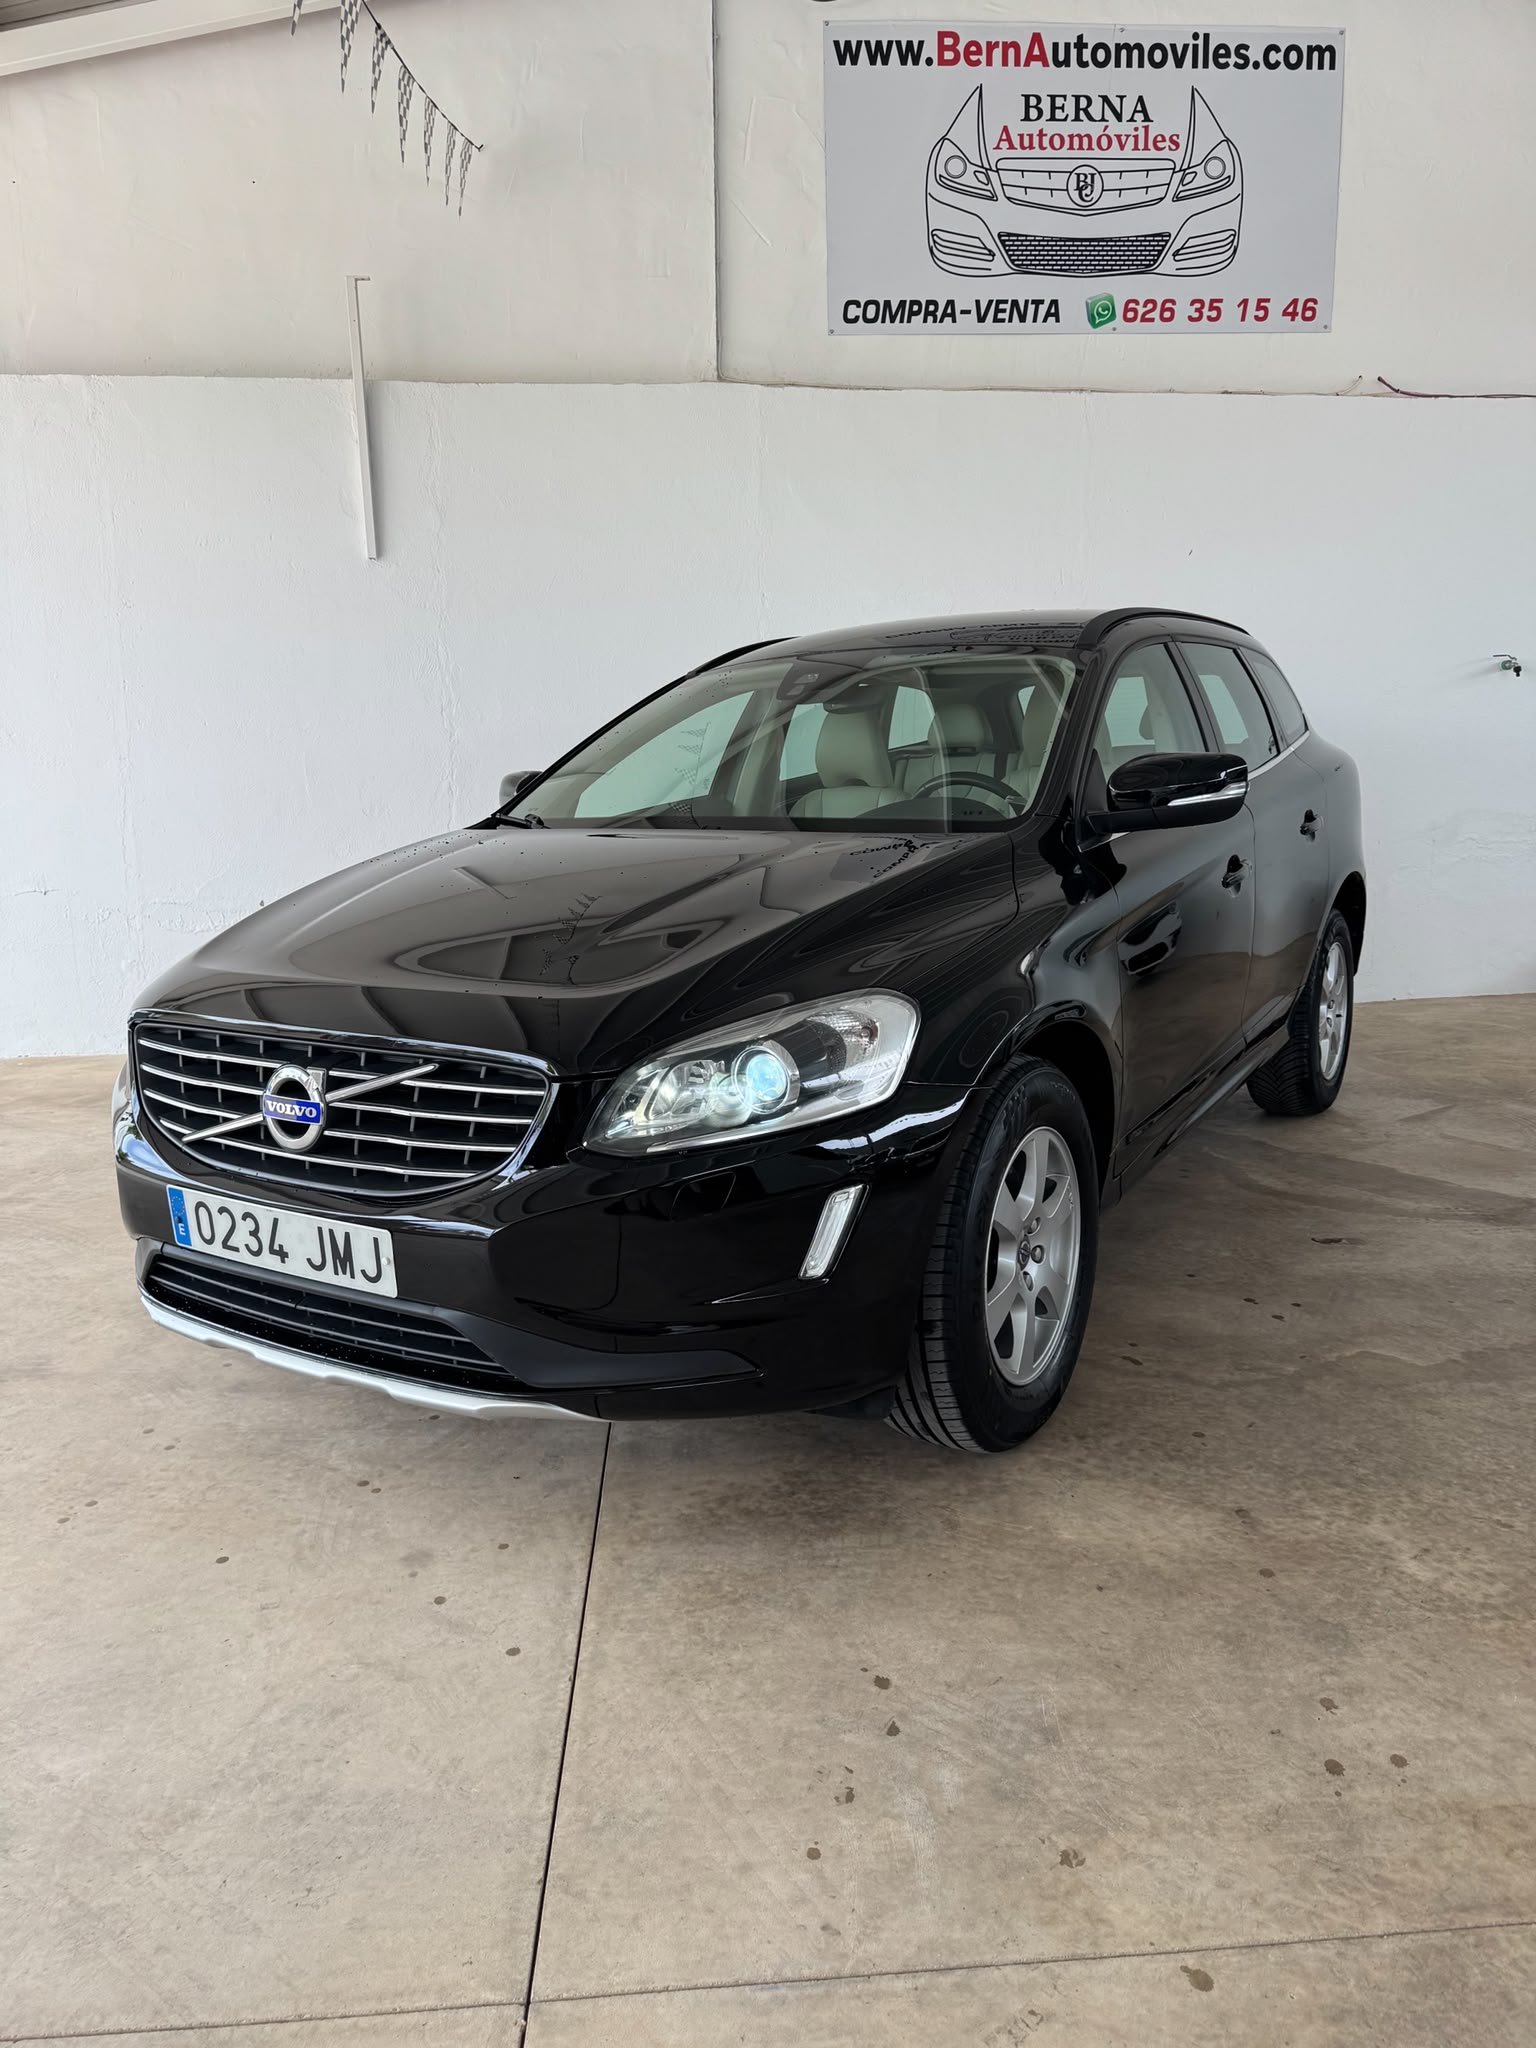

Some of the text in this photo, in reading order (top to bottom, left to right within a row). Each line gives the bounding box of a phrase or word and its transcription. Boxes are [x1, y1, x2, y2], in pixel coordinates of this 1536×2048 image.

[833, 31, 1337, 70] www.BernAutomoviles.com
[1020, 94, 1153, 123] BERNA
[993, 125, 1180, 152] Automóviles
[842, 299, 1060, 324] COMPRA-VENTA
[1122, 298, 1318, 323] 626 35 15 46
[266, 1100, 317, 1118] VOLVO
[178, 1223, 186, 1236] E
[195, 1201, 383, 1283] 0234 JMJ
